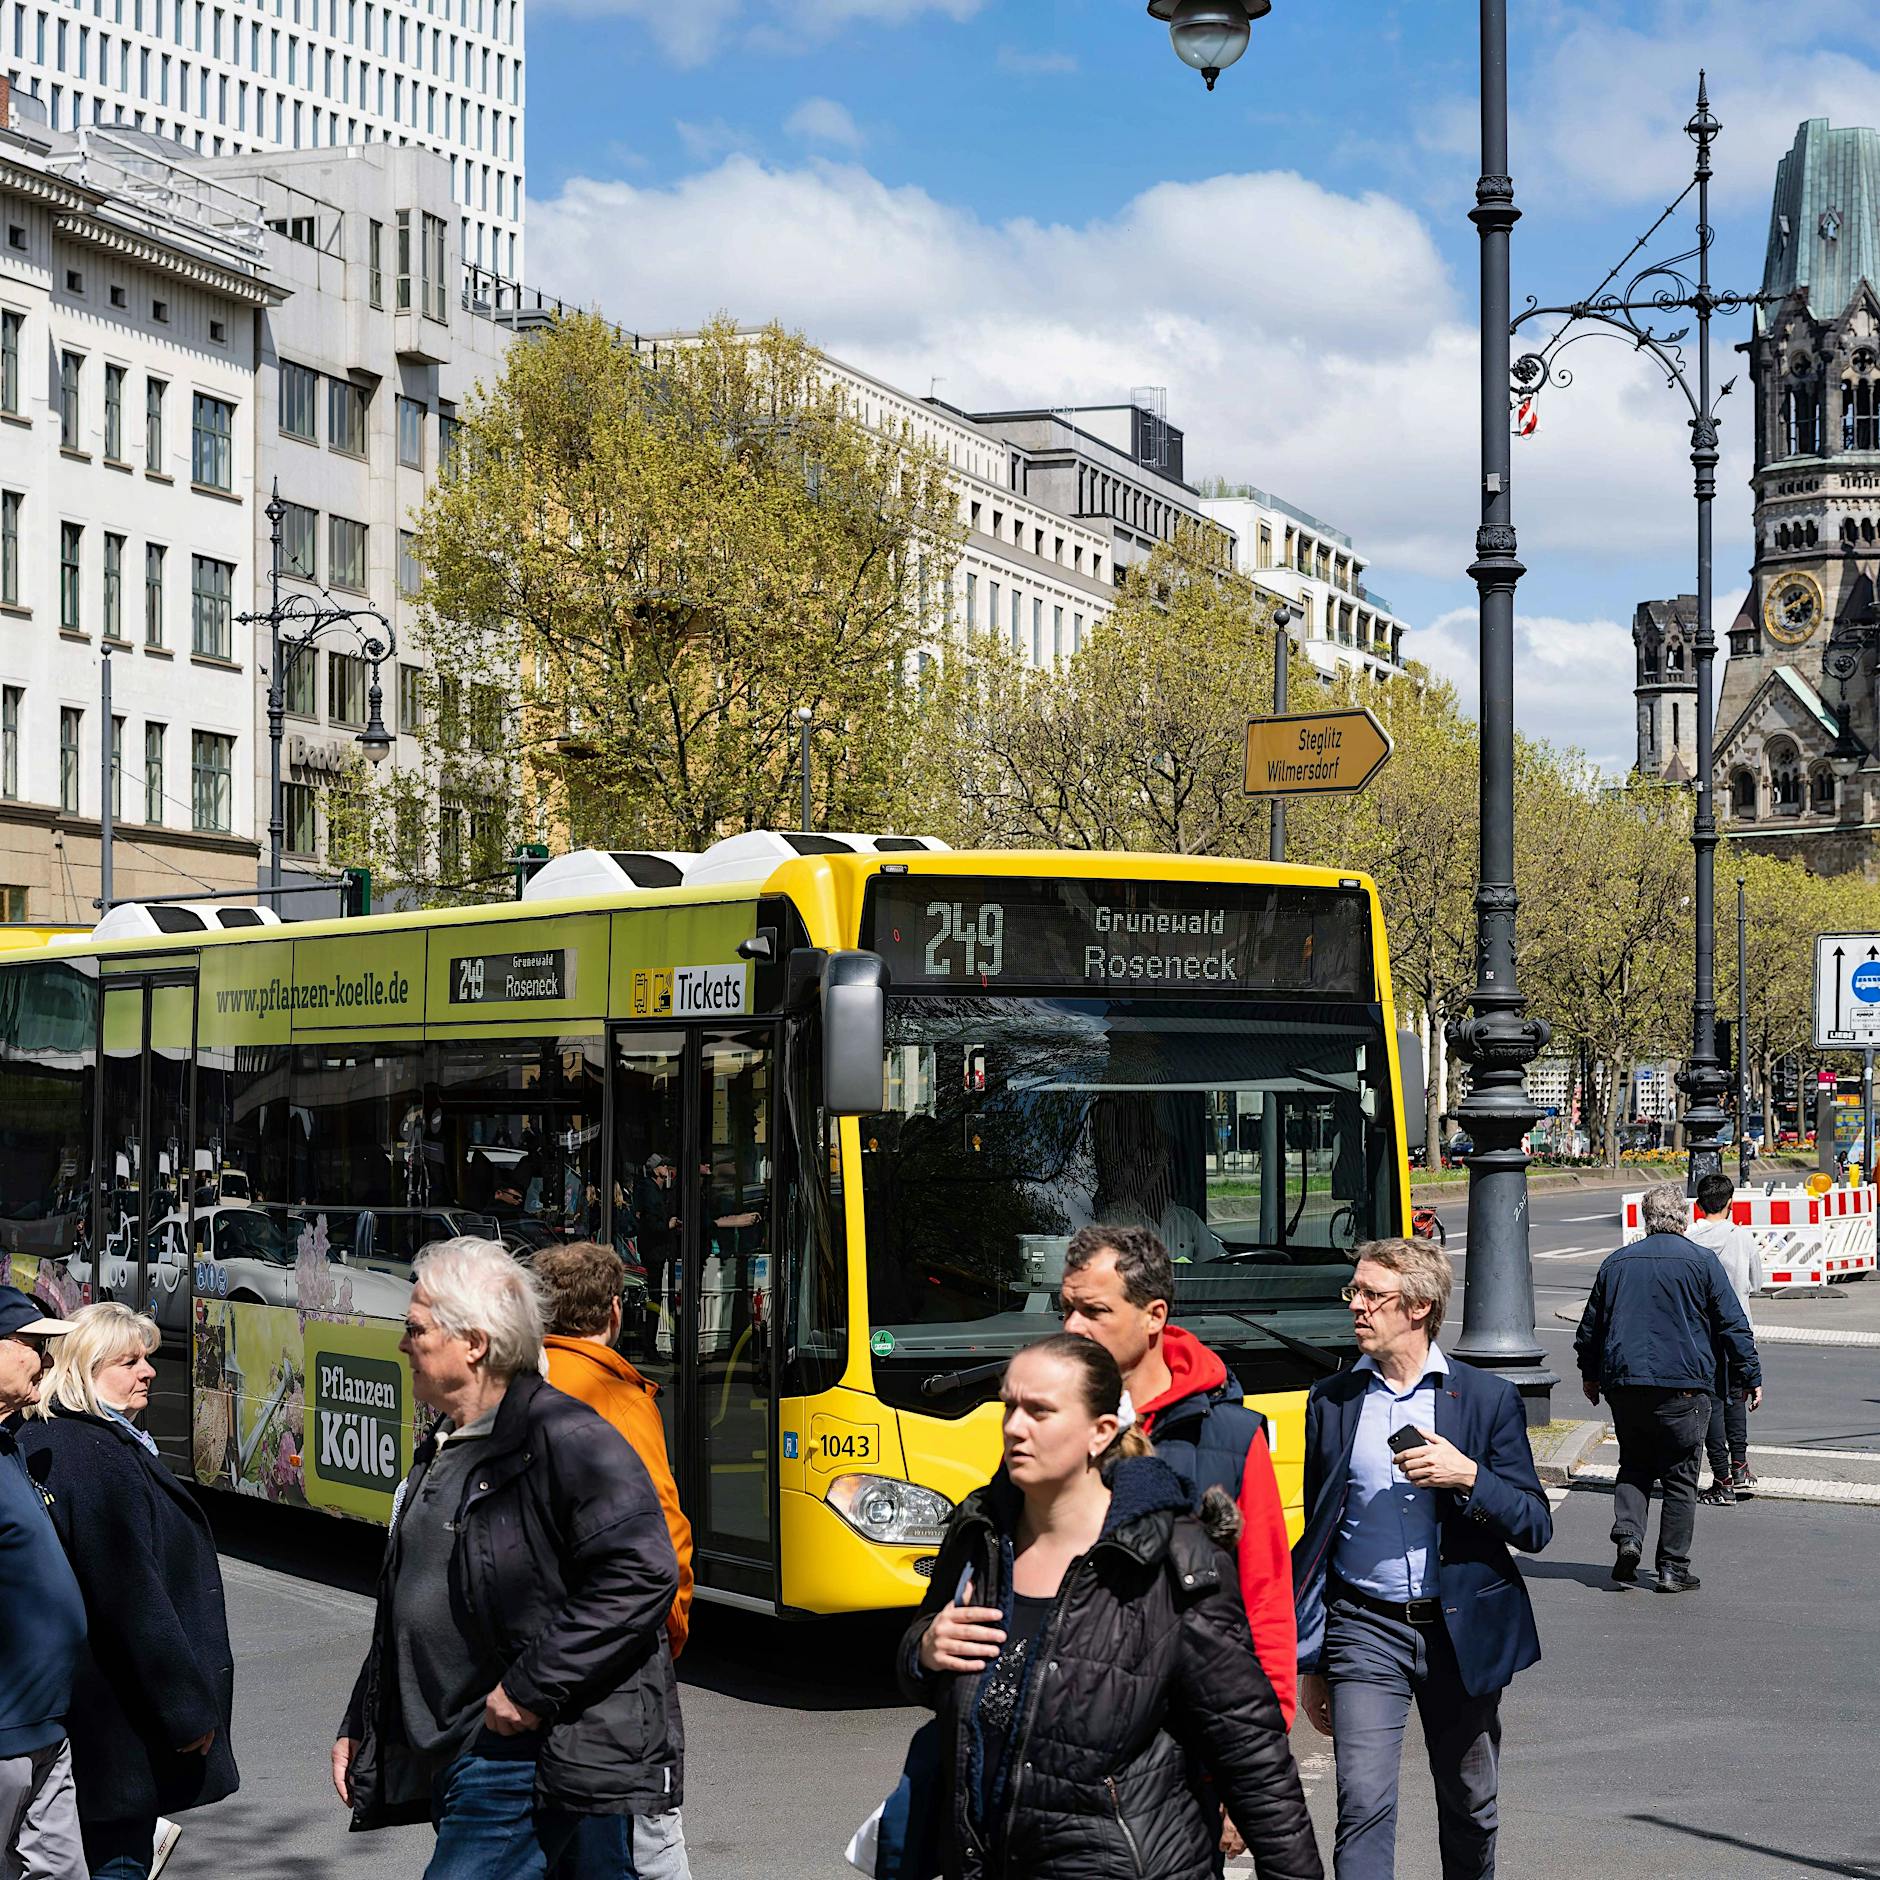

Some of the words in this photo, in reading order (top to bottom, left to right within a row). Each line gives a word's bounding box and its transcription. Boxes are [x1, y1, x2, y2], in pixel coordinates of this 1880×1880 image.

[1298, 726, 1342, 755] Steglitz
[1268, 757, 1340, 782] Wilmersdorf
[1095, 906, 1225, 935] Grunewald
[925, 901, 1004, 976] 249
[512, 953, 554, 968] Grunewald
[1084, 945, 1237, 981] Roseneck
[216, 970, 409, 1019] www.pflanzen-koelle.de
[459, 958, 485, 1000] 249
[505, 972, 558, 998] Roseneck
[678, 970, 740, 1010] Tickets
[879, 1332, 886, 1344] 4
[321, 1365, 396, 1410] Pflanzen
[320, 1411, 395, 1478] Kölle
[820, 1434, 870, 1458] 1043
